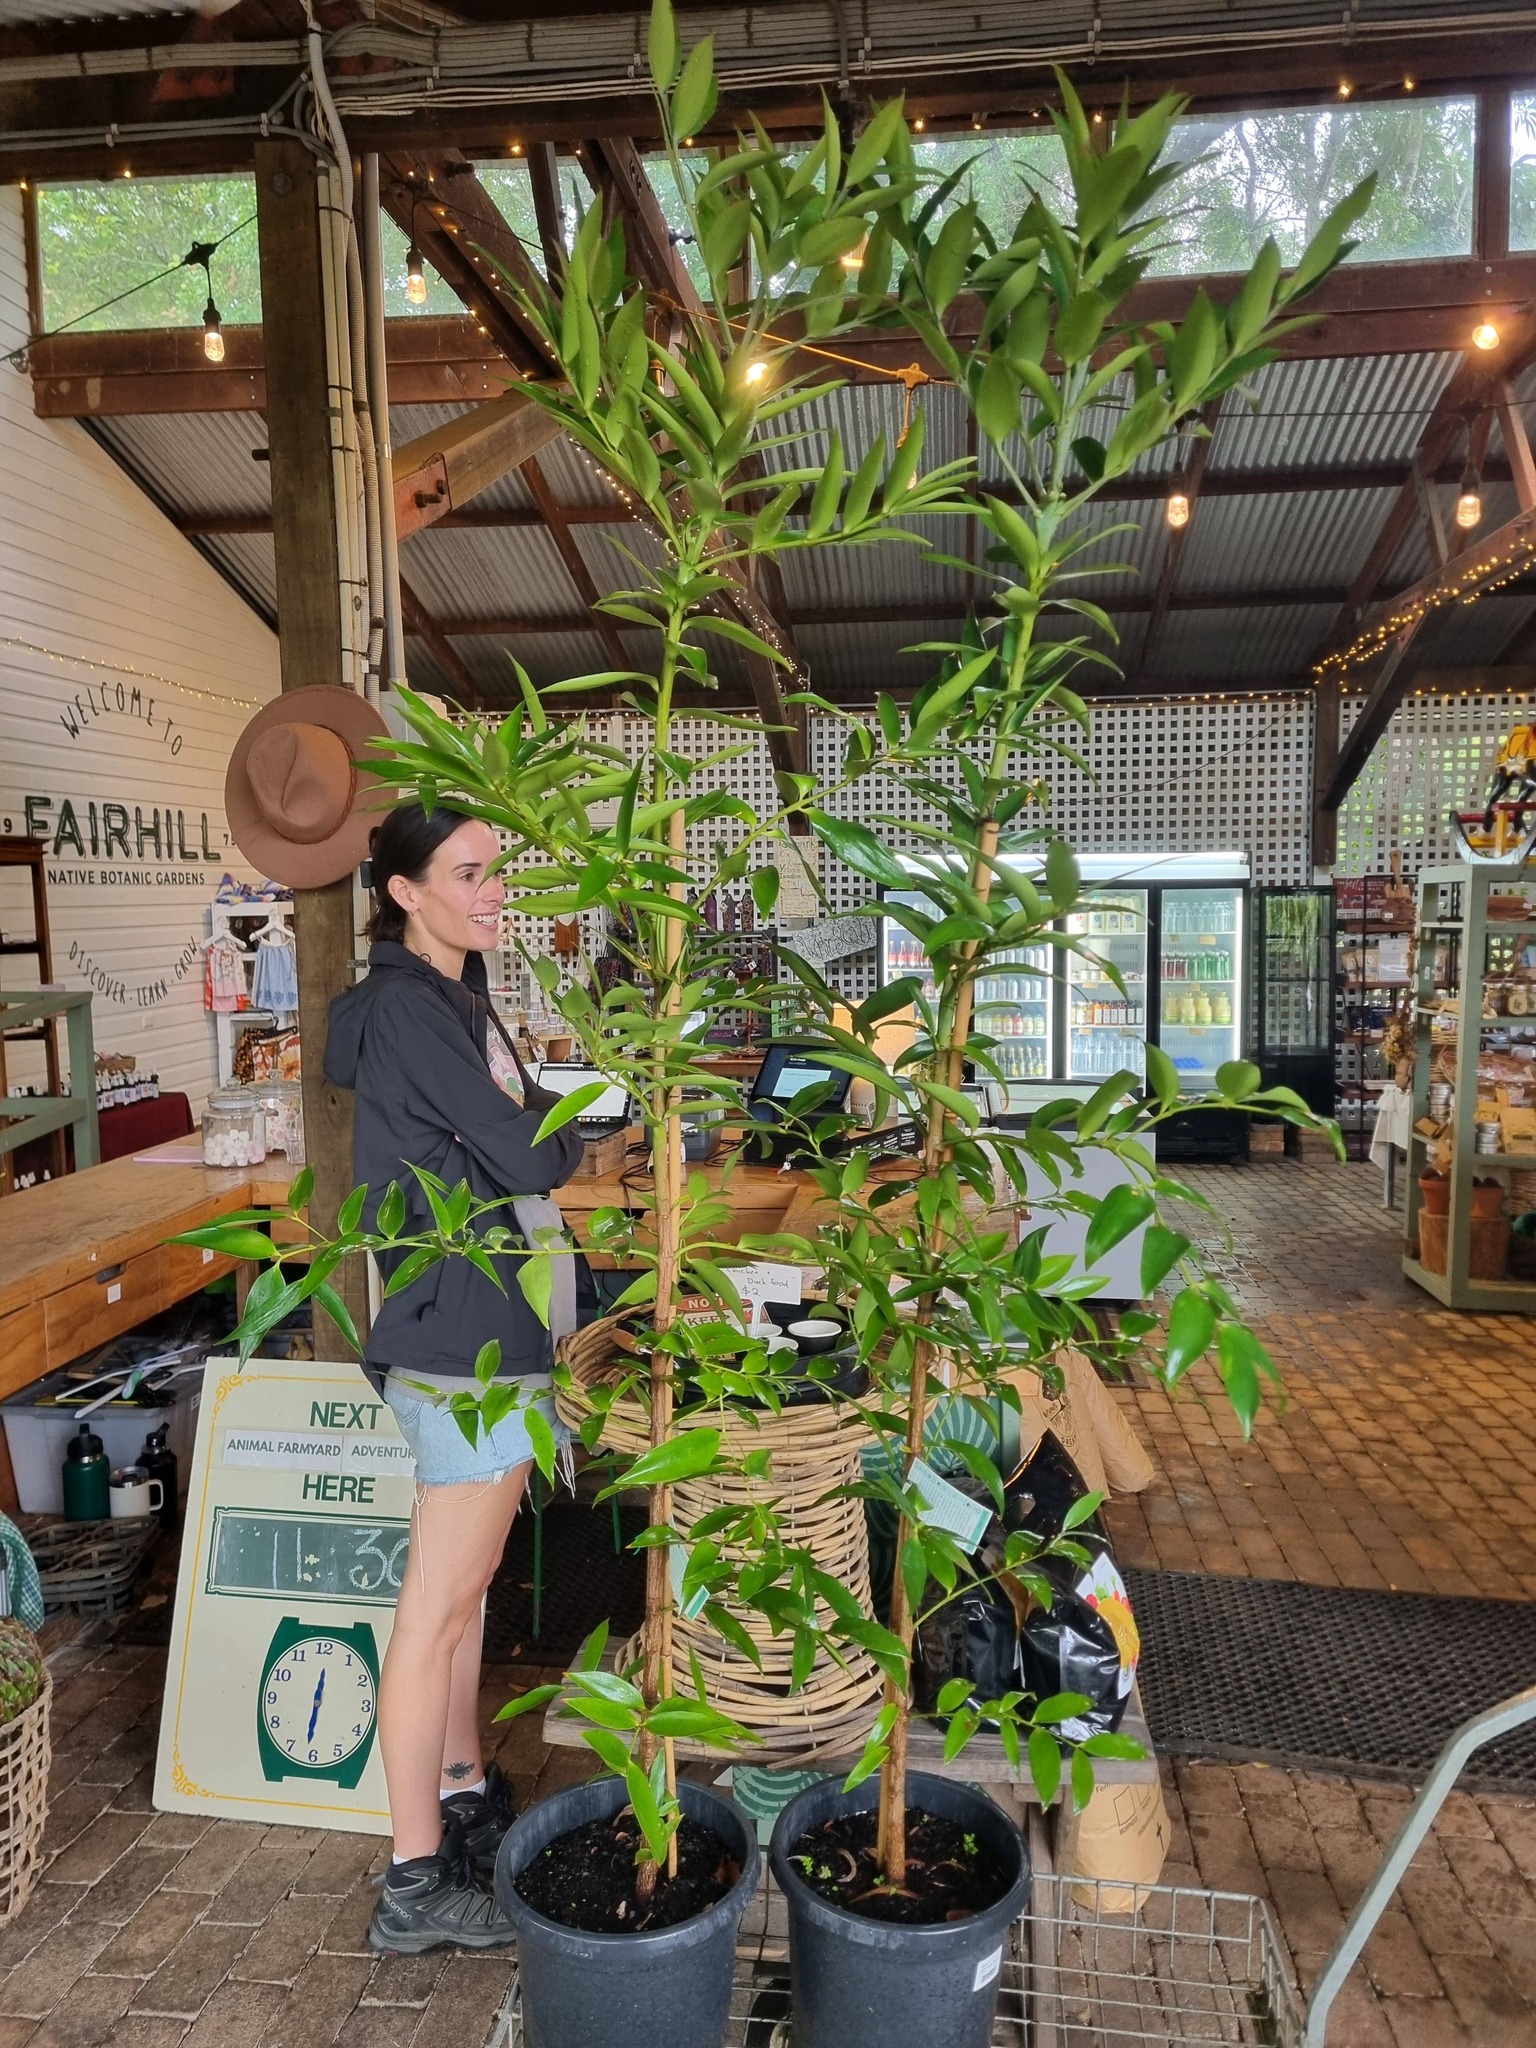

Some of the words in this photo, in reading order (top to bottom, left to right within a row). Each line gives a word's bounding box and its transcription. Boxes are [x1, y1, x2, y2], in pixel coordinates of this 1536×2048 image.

[60, 682, 155, 740] WELCOME
[164, 717, 182, 755] TO
[25, 796, 222, 863] FAIRHILL
[48, 869, 95, 884] NATIVE
[100, 871, 151, 885] BOTANIC
[156, 872, 205, 885] GARDENS
[69, 941, 125, 1004] DISCOVER
[137, 978, 168, 1006] LEARN
[175, 936, 197, 980] GROW
[747, 1277, 766, 1285] Duck
[770, 1278, 789, 1289] food
[741, 1285, 761, 1297] $2
[310, 1401, 384, 1430] NEXT
[227, 1439, 274, 1453] ANIMAL
[277, 1441, 341, 1457] FARMYARD
[302, 1474, 376, 1504] HERE
[315, 1642, 333, 1655] 12
[291, 1649, 306, 1662] 11
[345, 1654, 353, 1666] 1
[273, 1669, 291, 1682] 10
[357, 1674, 368, 1687] 2
[267, 1691, 277, 1704] 9
[361, 1700, 371, 1712] 3
[270, 1716, 280, 1728] 8
[352, 1724, 362, 1736] 4
[286, 1739, 296, 1752] 7
[333, 1744, 342, 1757] 5
[308, 1750, 318, 1762] 6
